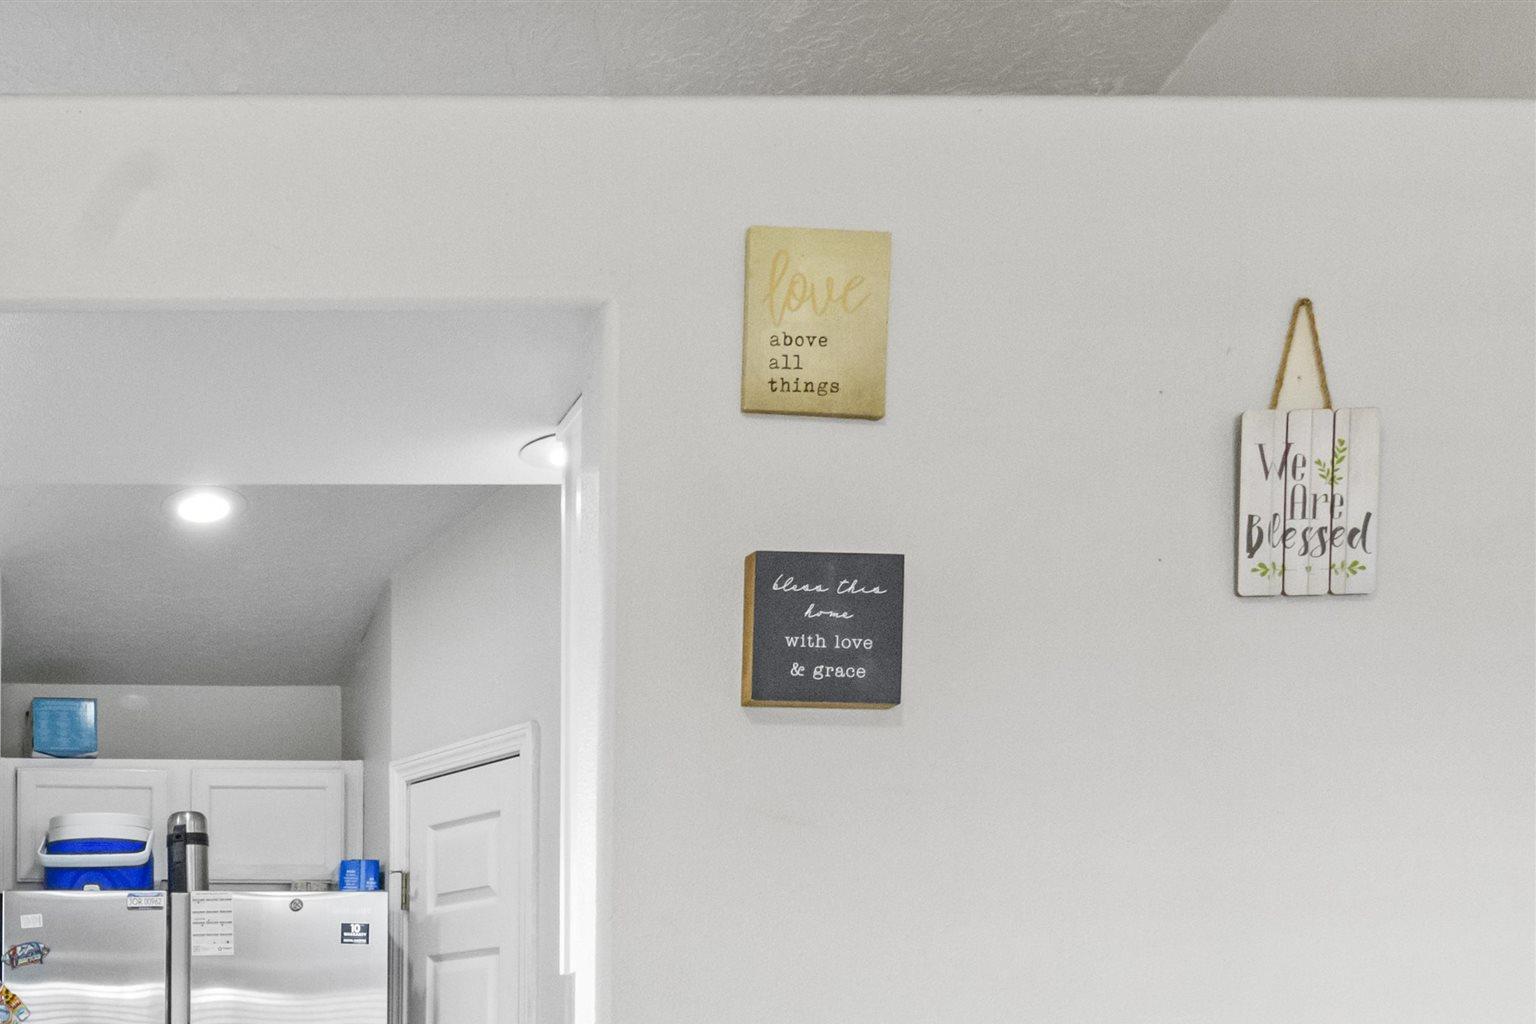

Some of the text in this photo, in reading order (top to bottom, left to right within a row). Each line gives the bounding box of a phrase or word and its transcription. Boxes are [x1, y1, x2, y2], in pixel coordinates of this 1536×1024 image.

[765, 249, 871, 327] love
[769, 332, 829, 347] above
[768, 354, 803, 370] all
[767, 378, 840, 396] things
[1255, 443, 1307, 481] We
[1286, 483, 1344, 520] Are
[1246, 511, 1372, 559] Blessed
[772, 574, 888, 595] bless this
[803, 603, 854, 619] home
[784, 634, 873, 649] with love
[790, 662, 866, 680] & grace
[350, 923, 361, 933] 10
